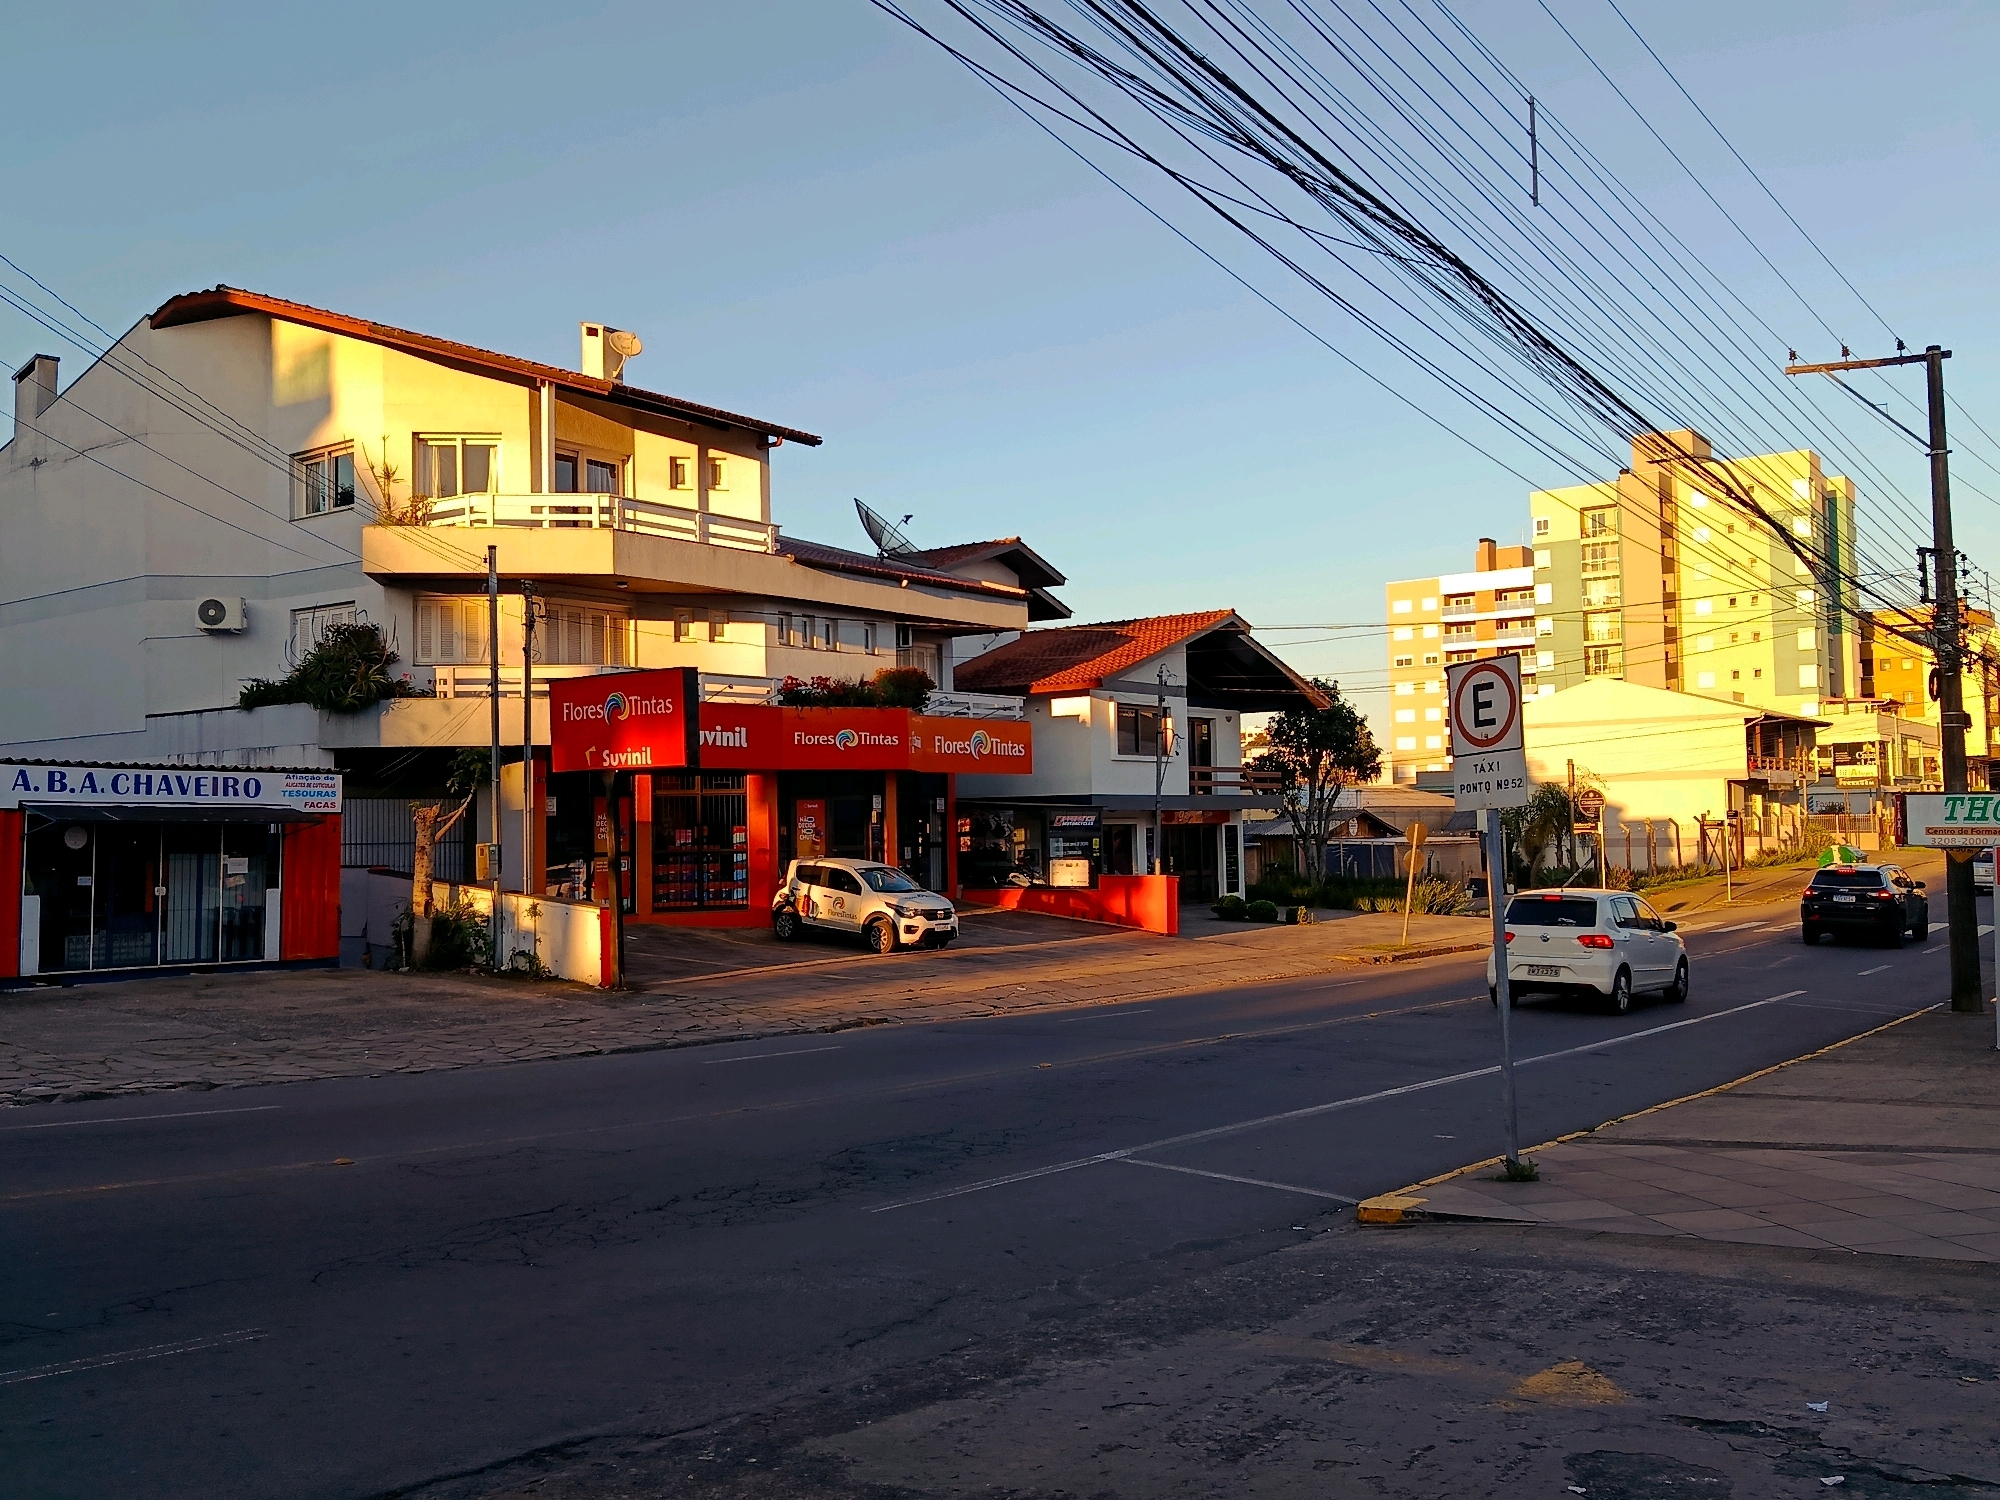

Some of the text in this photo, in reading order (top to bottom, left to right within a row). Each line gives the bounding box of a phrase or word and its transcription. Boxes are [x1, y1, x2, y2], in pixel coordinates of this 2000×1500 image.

[563, 695, 673, 721] Flores Tintas
[1472, 681, 1497, 729] E
[794, 731, 835, 745] Flores
[858, 731, 899, 746] Tintas
[934, 735, 971, 754] Flores
[990, 737, 1025, 756] Tintas
[602, 746, 652, 767] Suvinil
[1473, 758, 1500, 774] TÁXI
[110, 773, 262, 799] CHAVEIRO
[281, 789, 337, 798] TESOURAS
[1460, 780, 1491, 795] PONTO
[303, 801, 337, 809] FACAS
[1926, 828, 1956, 836] Centro
[1957, 828, 1969, 836] de
[1930, 837, 1989, 846] 3208-2000
